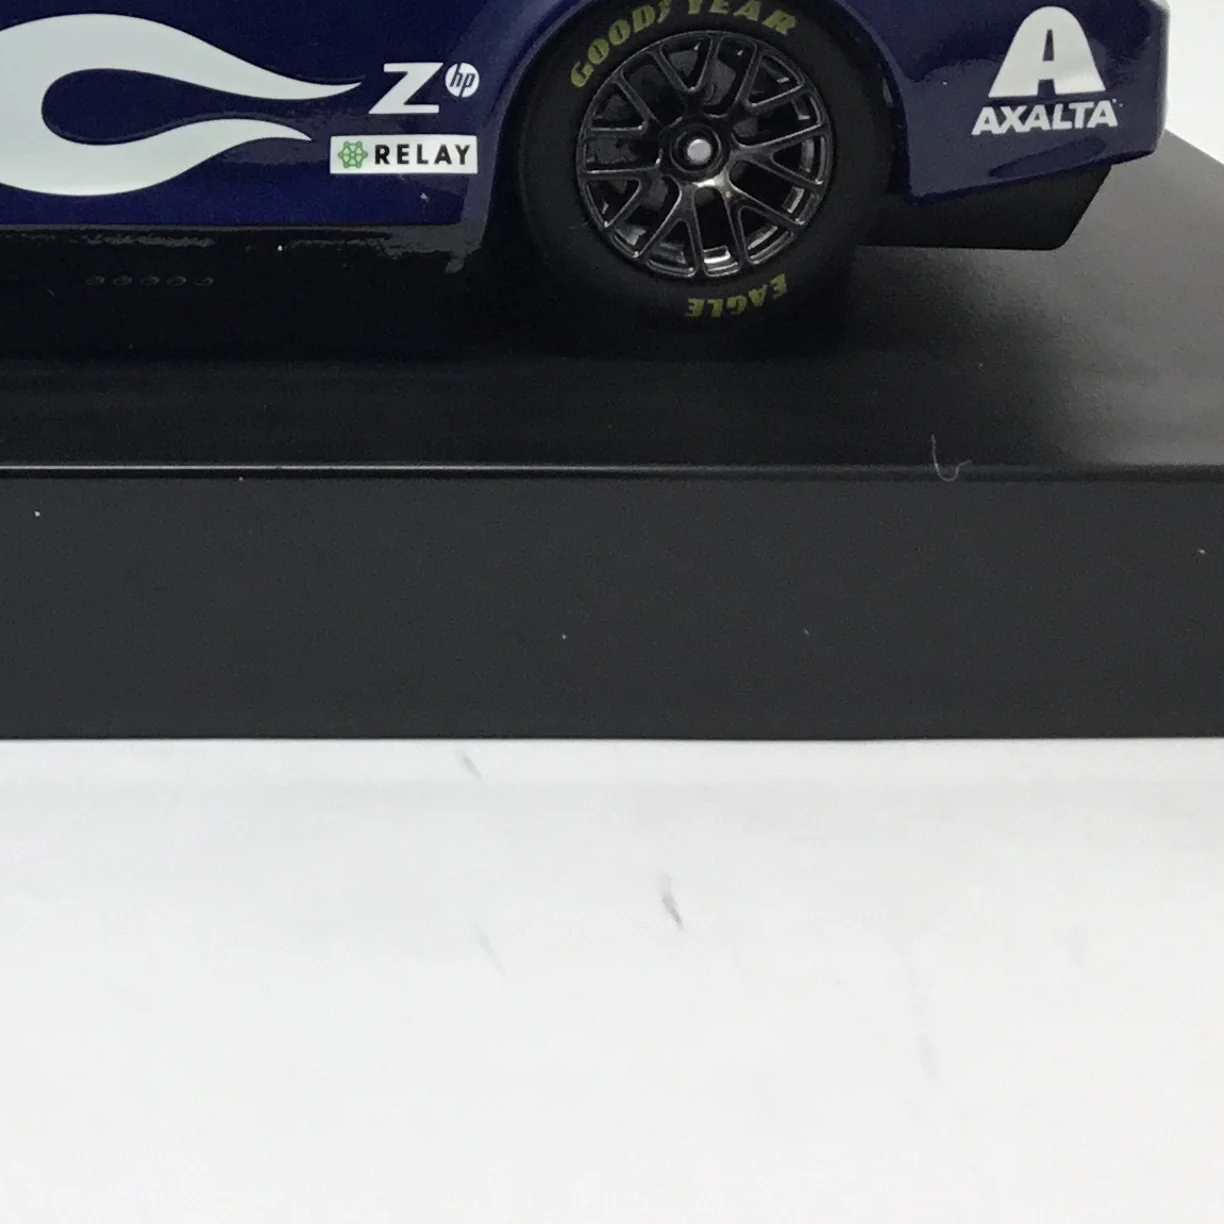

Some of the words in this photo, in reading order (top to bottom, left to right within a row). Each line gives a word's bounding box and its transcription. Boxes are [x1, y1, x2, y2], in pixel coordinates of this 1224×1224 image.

[971, 99, 1119, 136] AXALTA
[374, 144, 471, 165] RELAY
[684, 274, 787, 317] EAGLE
